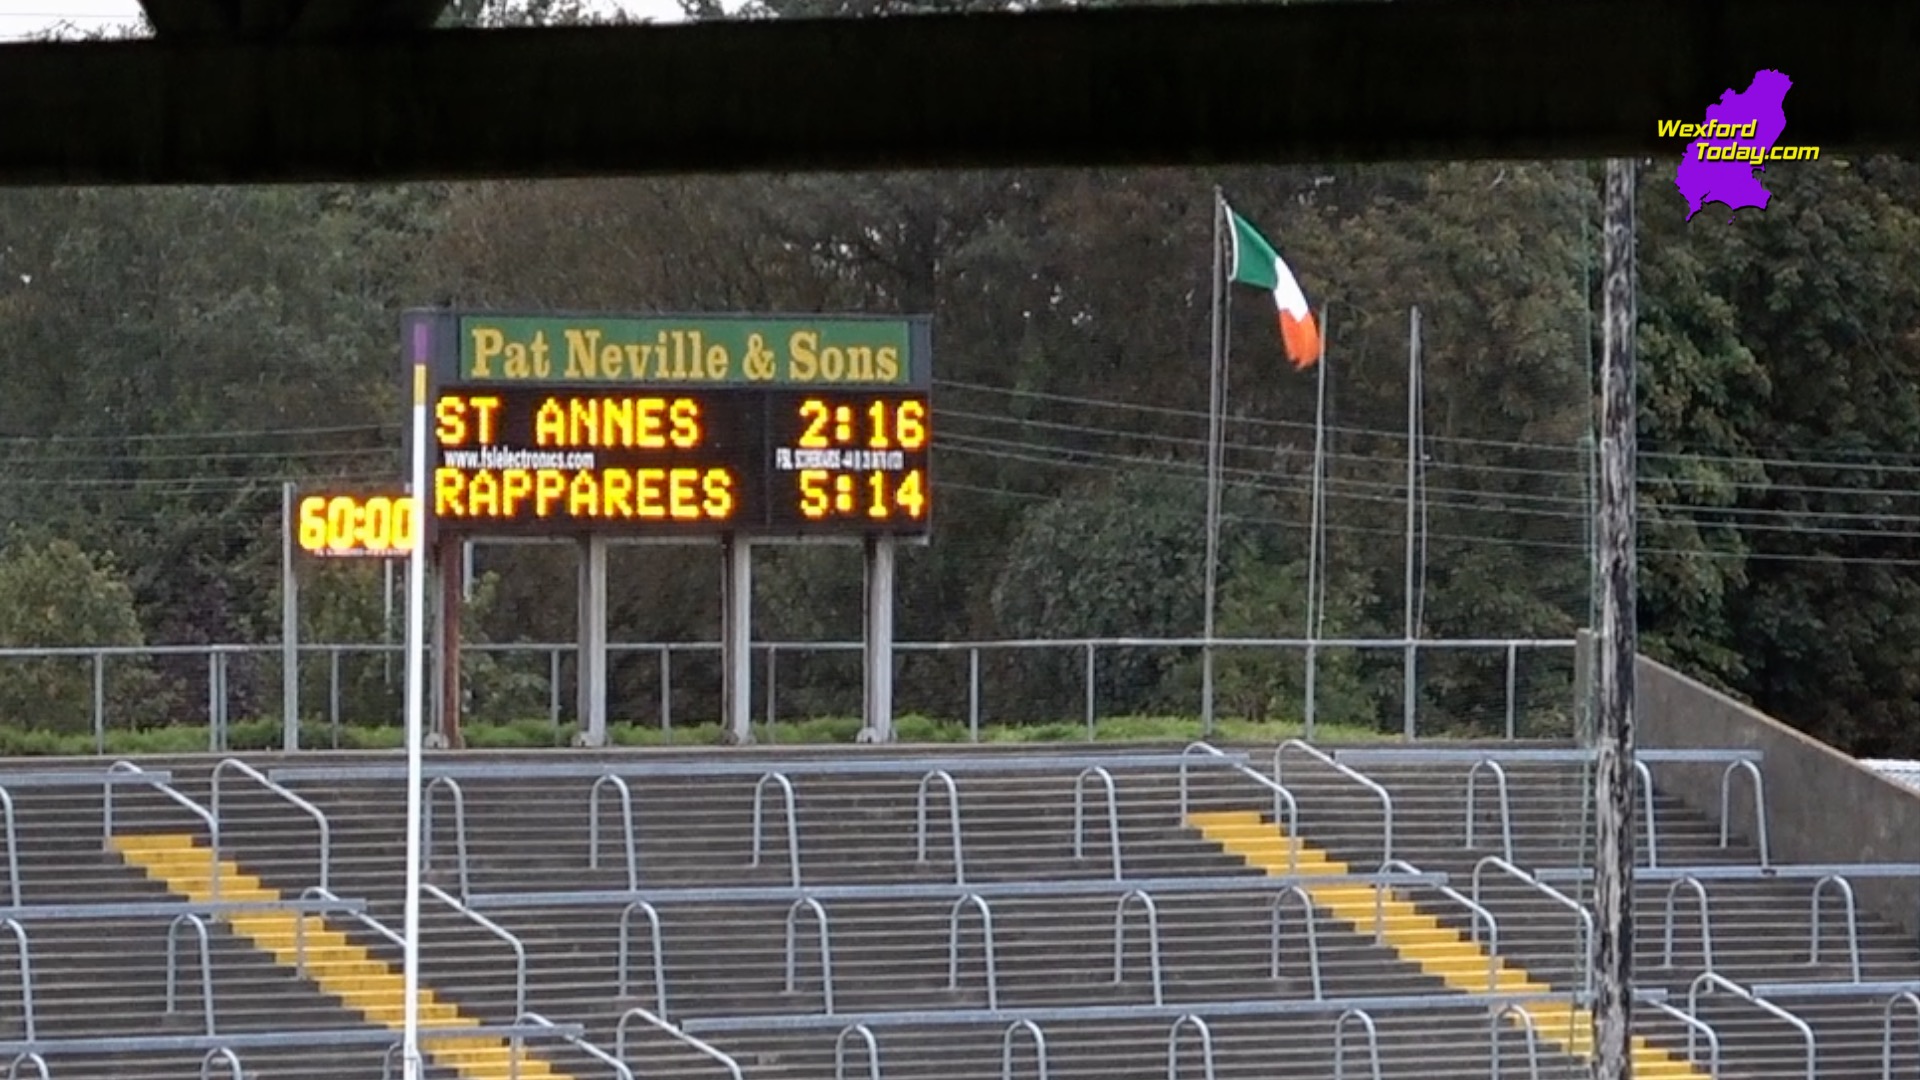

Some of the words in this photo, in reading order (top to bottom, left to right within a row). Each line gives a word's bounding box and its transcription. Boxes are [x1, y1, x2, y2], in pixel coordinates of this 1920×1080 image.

[470, 327, 551, 380] Pat
[564, 328, 730, 381] Neville
[742, 332, 776, 381] &
[788, 331, 899, 383] Sons
[435, 396, 500, 445] ST
[535, 398, 700, 448] ANNES
[798, 399, 926, 449] 2:16
[444, 446, 595, 469] www.fslelectronics.com
[434, 468, 733, 518] RAPPAREES
[799, 469, 926, 518] 5:14
[299, 495, 416, 551] 60:00
